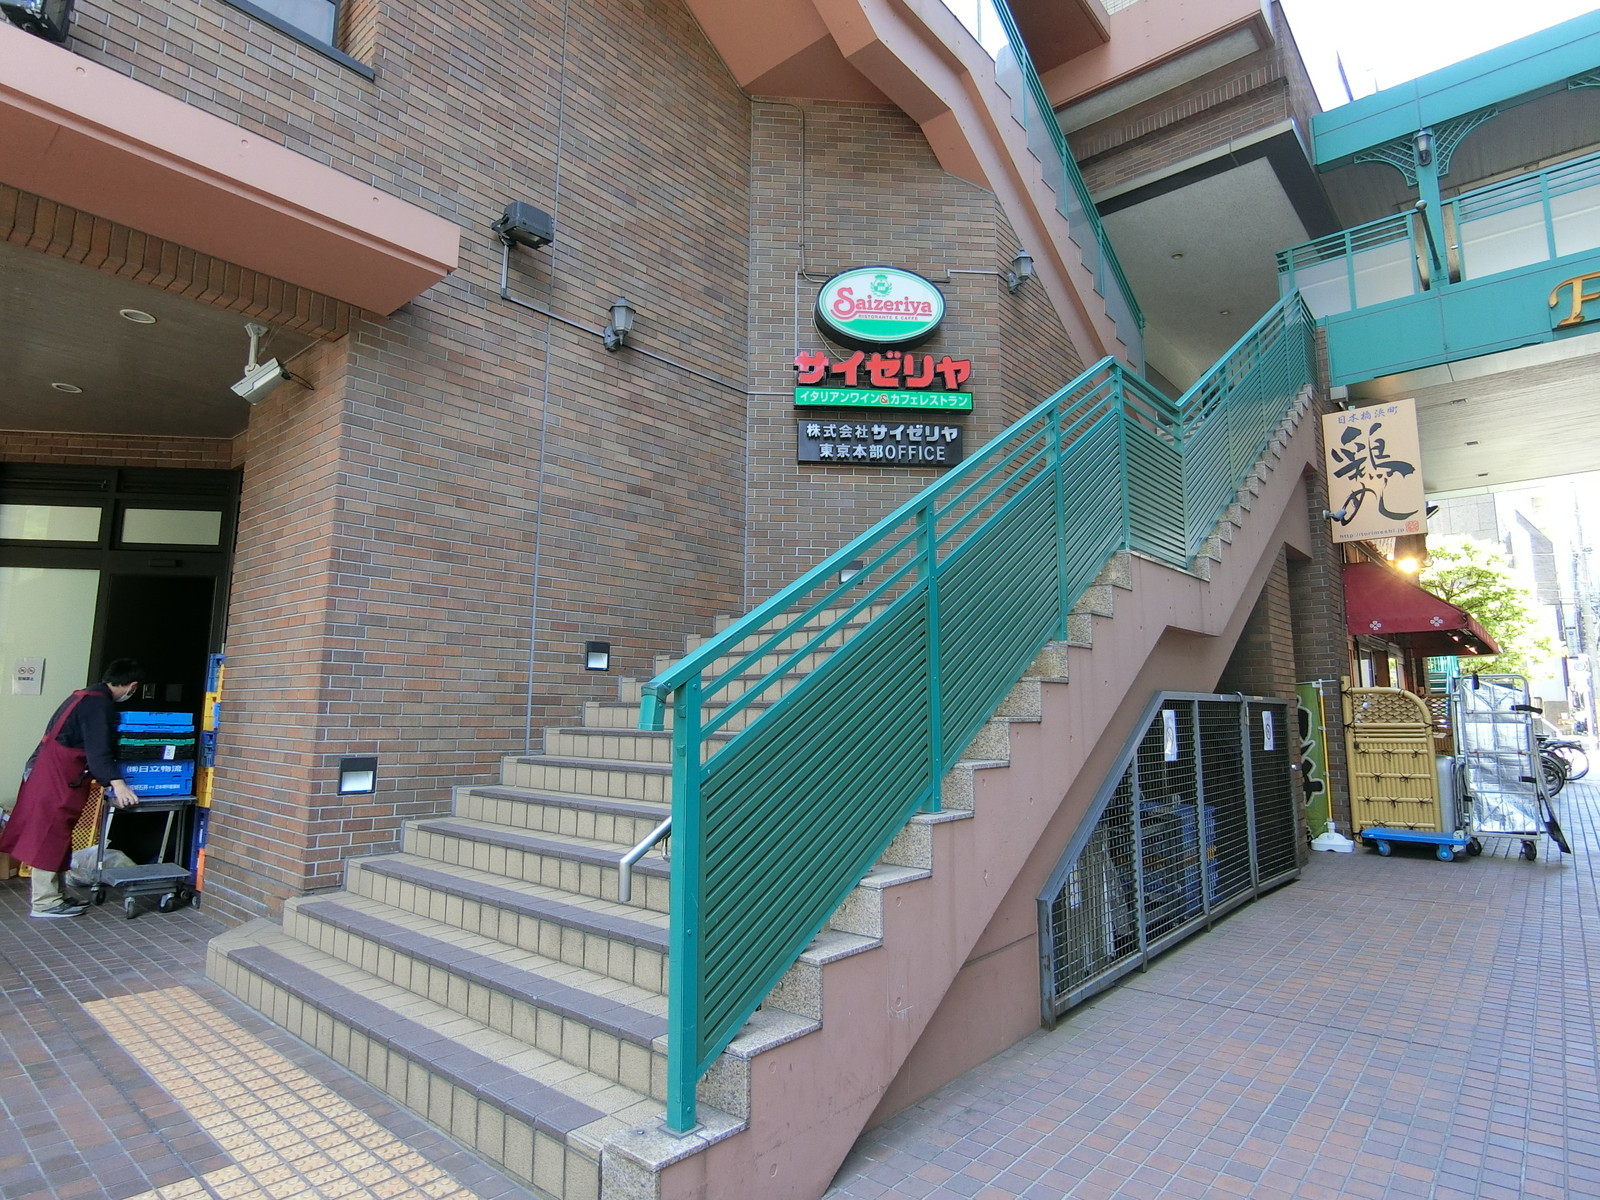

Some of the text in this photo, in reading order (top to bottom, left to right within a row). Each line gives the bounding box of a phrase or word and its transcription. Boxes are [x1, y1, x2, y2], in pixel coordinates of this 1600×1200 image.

[833, 287, 932, 317] Saizeriya
[795, 350, 971, 390] サイゼリヤ
[800, 390, 968, 406] イタリアンワイン&カフェレストラン
[1338, 406, 1398, 424] 日本橋浜町
